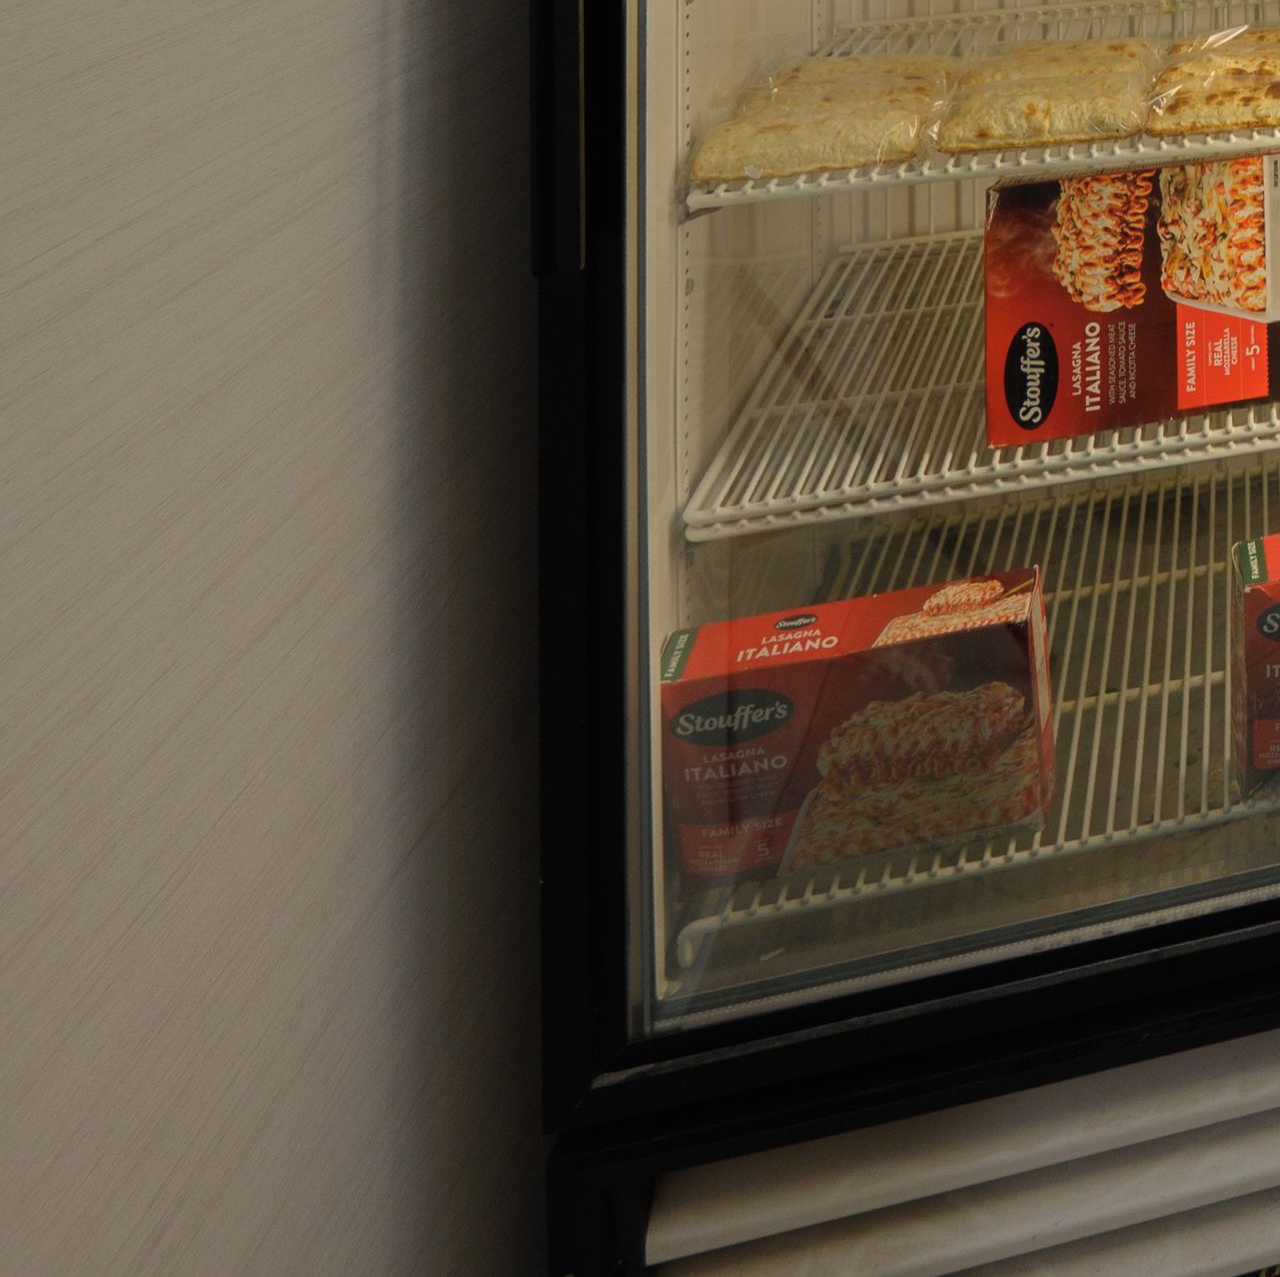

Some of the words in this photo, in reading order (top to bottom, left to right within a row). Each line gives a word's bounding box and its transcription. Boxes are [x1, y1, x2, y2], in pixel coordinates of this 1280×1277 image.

[1185, 321, 1196, 347] SIZE
[1213, 338, 1223, 367] REAL
[1245, 345, 1260, 356] 5
[1019, 326, 1045, 423] Stouffer's
[1071, 341, 1082, 396] LASAGNA
[1084, 321, 1101, 412] ITALIANO
[1186, 349, 1196, 392] FAMILY
[735, 635, 839, 663] ITALIANO
[760, 628, 821, 646] LASAGNA
[674, 700, 789, 736] Stouffer's
[684, 754, 788, 783] ITALIANO
[703, 746, 766, 764] LASAGNA
[701, 824, 752, 839] FAMILY
[753, 817, 784, 832] SIZE
